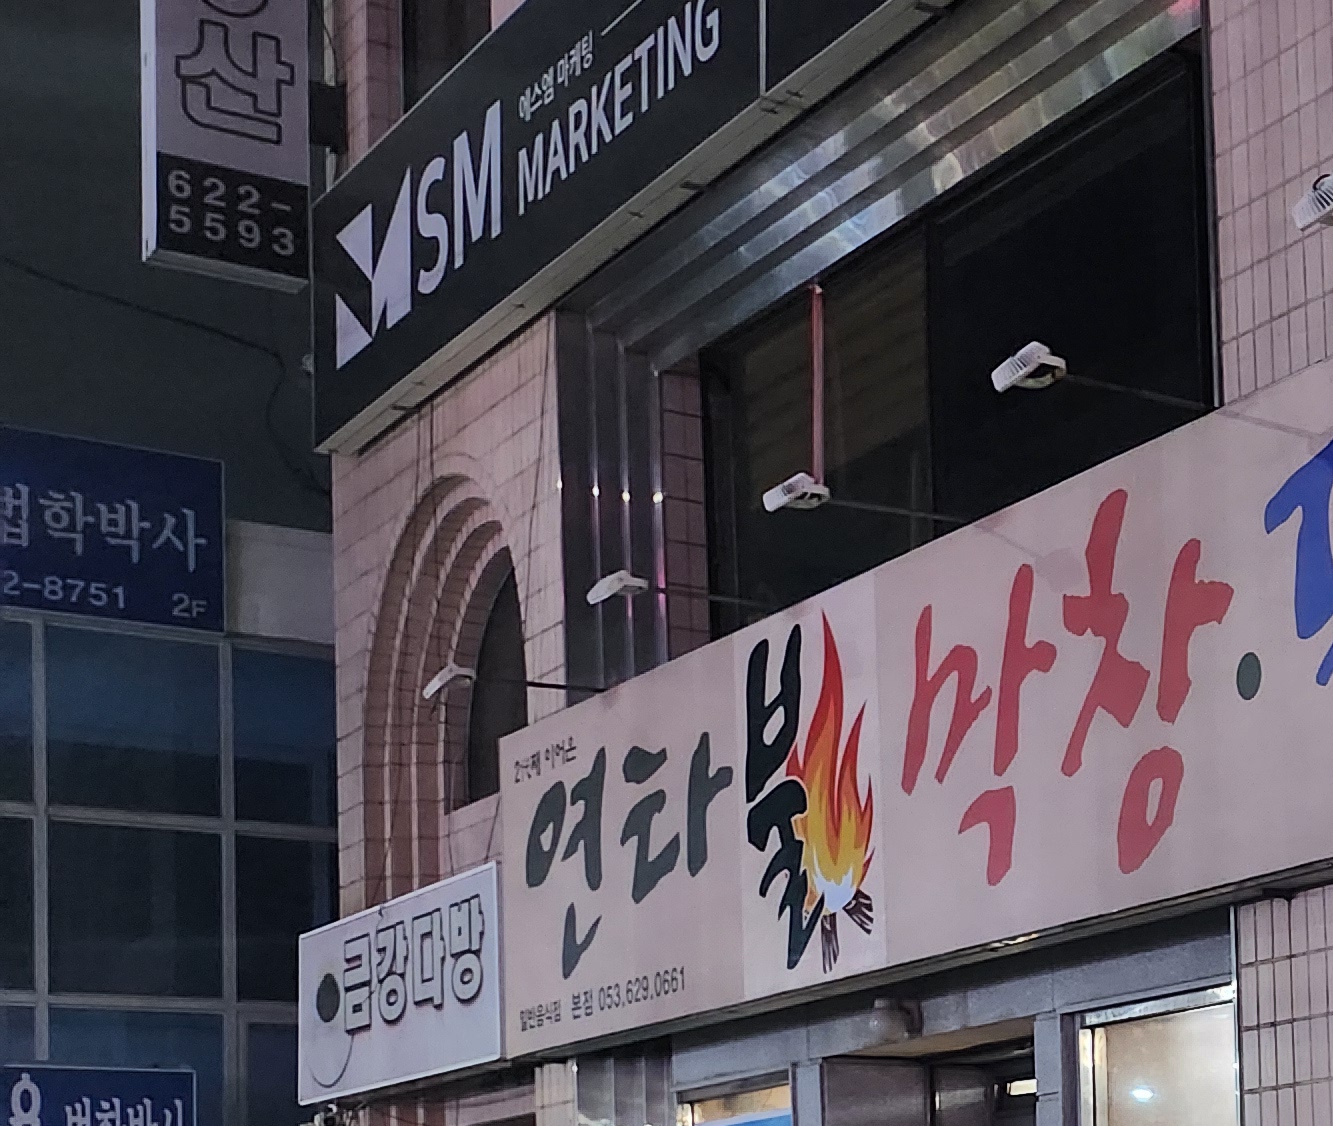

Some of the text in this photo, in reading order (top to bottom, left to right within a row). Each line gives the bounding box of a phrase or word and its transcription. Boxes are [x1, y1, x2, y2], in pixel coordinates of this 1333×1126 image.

[175, 0, 295, 144] 산
[518, 0, 720, 216] MARKETING
[168, 169, 293, 212] 622-
[168, 205, 296, 257] 5593
[172, 593, 208, 619] 2F
[343, 894, 484, 1034] 금강다방
